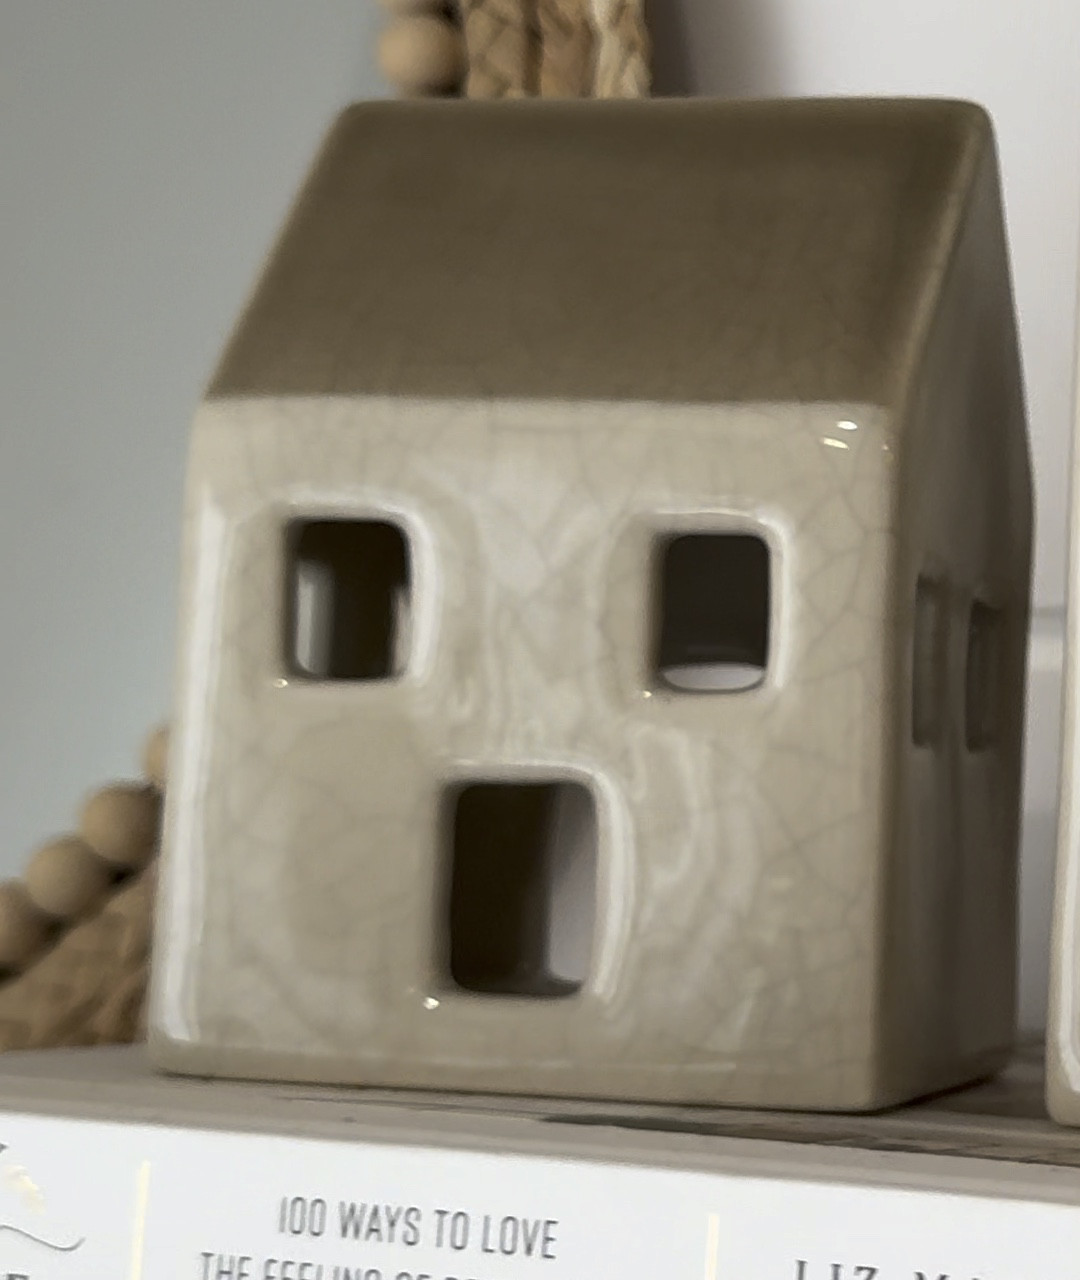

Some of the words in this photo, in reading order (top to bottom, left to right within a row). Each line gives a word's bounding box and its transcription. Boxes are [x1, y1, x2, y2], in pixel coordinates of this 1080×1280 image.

[279, 1197, 326, 1237] 100
[339, 1202, 421, 1246] WAYS
[434, 1210, 469, 1251] TO
[482, 1216, 558, 1259] LOVE
